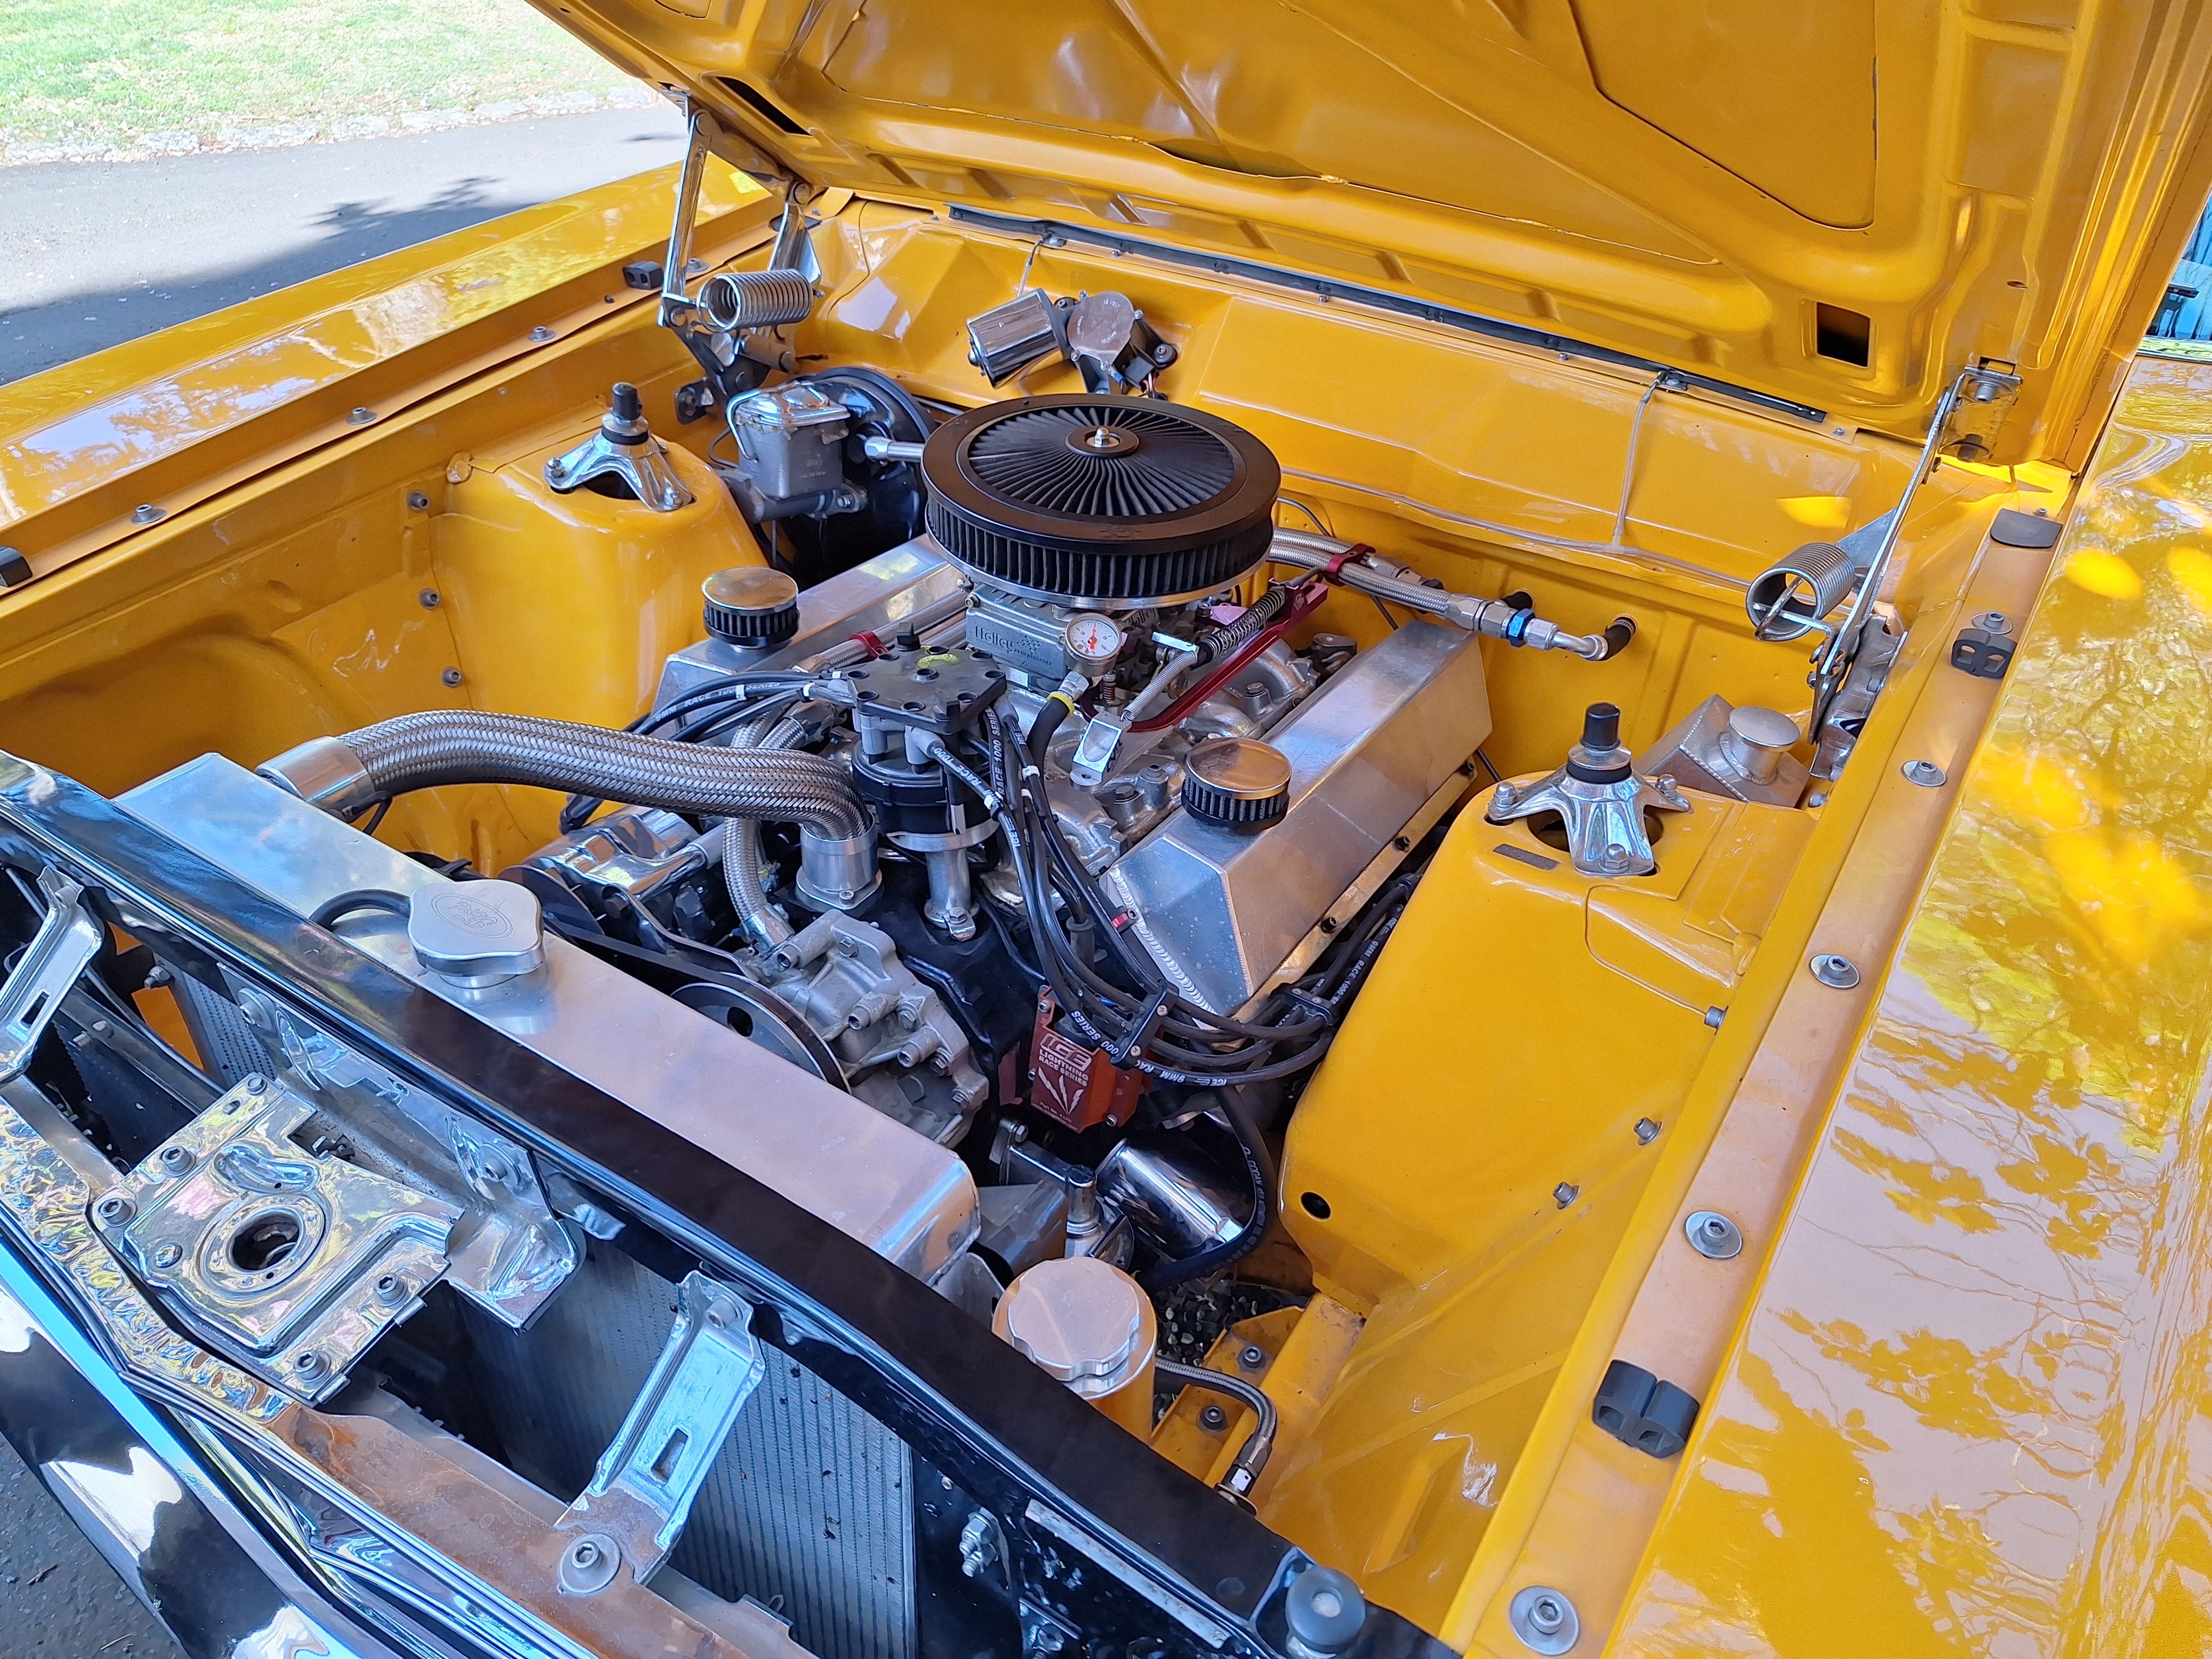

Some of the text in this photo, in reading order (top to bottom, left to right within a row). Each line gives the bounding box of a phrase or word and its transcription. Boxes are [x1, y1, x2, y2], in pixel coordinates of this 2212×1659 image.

[975, 626, 1013, 654] Holley
[655, 706, 678, 723] 9MM
[684, 692, 713, 708] RACE
[717, 685, 737, 697] 100
[985, 709, 1005, 795] RACE 1000 SERIES
[934, 747, 983, 787] RACE 1000
[447, 901, 498, 929] Ford
[1348, 959, 1366, 980] RACE
[1336, 980, 1351, 996] 1000
[1071, 1010, 1102, 1040] SERIES
[1039, 1033, 1092, 1072] ICE
[1039, 1049, 1089, 1082] LIGHTNING
[1134, 1058, 1155, 1073] RAC
[1038, 1055, 1088, 1087] RACE SERIES
[1159, 1070, 1186, 1083] 9MM
[1210, 1077, 1227, 1086] ICE
